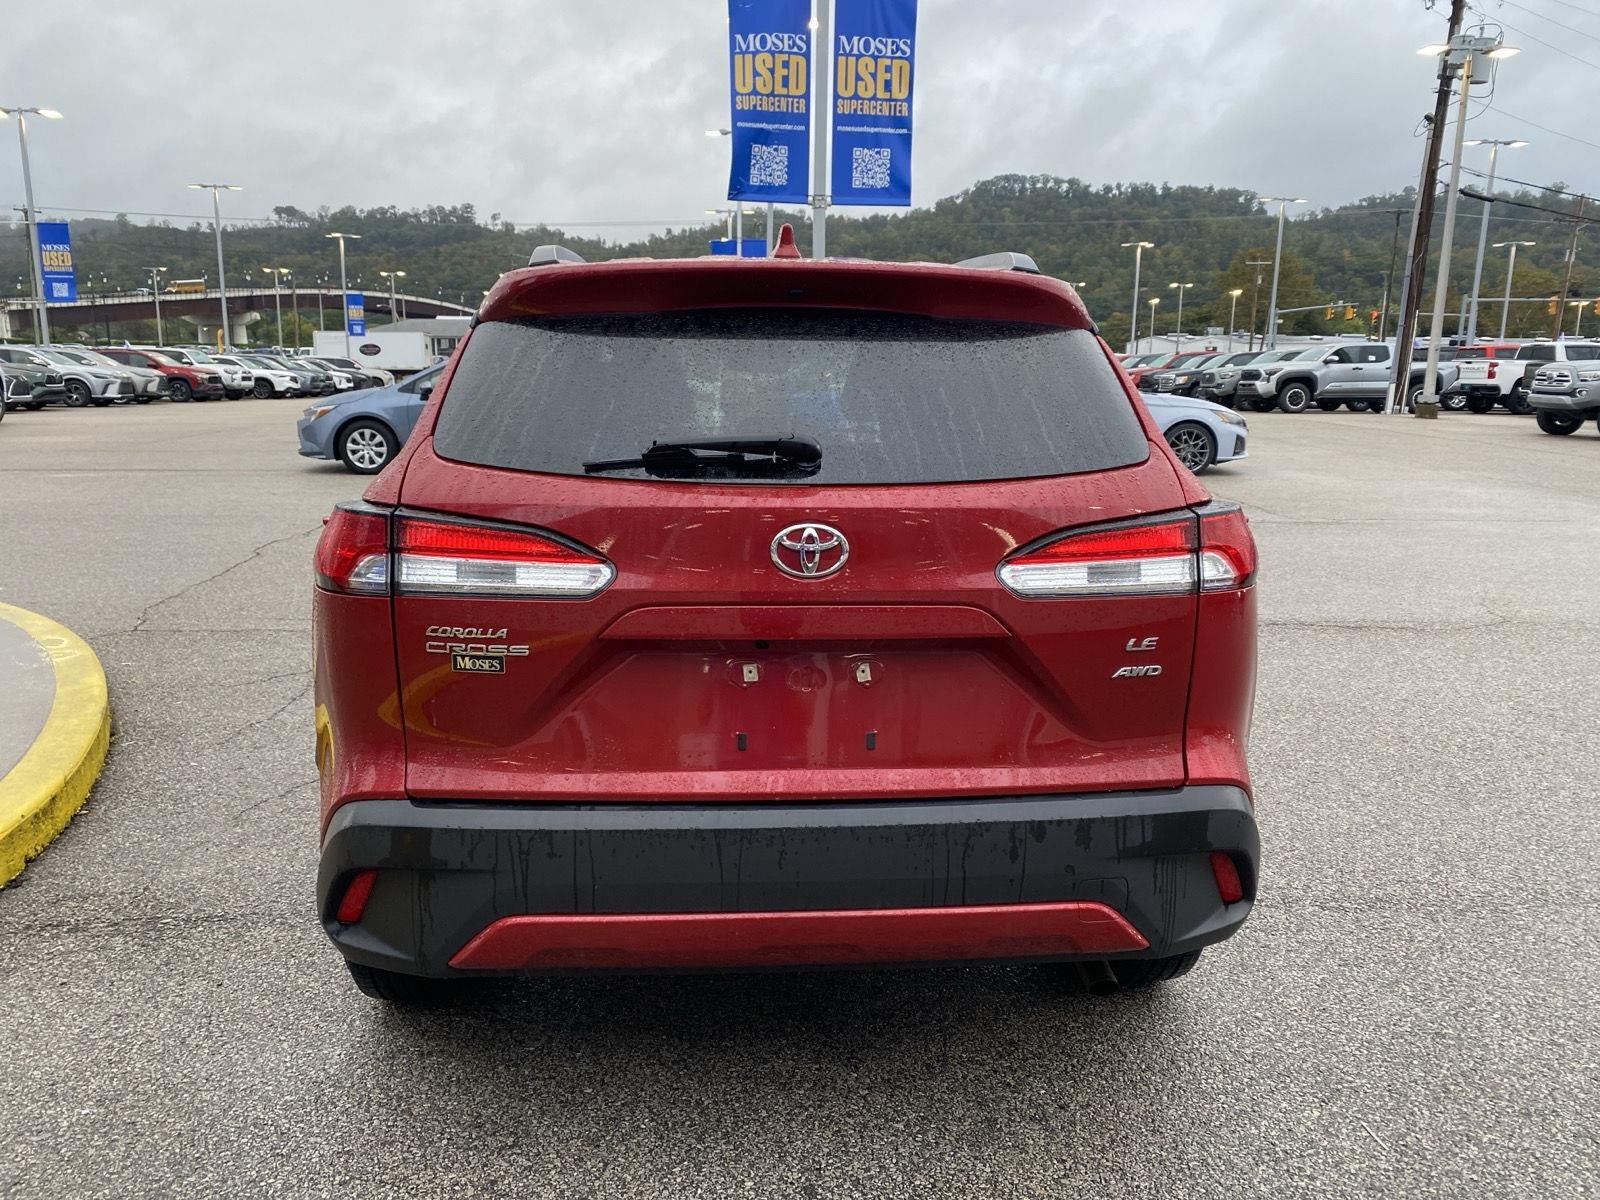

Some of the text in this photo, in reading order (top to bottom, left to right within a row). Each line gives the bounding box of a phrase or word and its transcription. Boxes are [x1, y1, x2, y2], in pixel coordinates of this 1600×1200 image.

[734, 33, 807, 53] MOSES
[838, 35, 911, 57] MOSES
[734, 52, 807, 96] USED
[837, 56, 911, 99] USED
[736, 95, 806, 114] SUPERCENTER
[837, 99, 909, 117] SUPERCENTER
[42, 251, 72, 266] USED
[425, 625, 508, 639] COROLLA
[425, 641, 530, 656] CROSS
[1125, 636, 1159, 651] LE
[456, 656, 501, 671] MOSES
[1111, 665, 1162, 678] AWD
